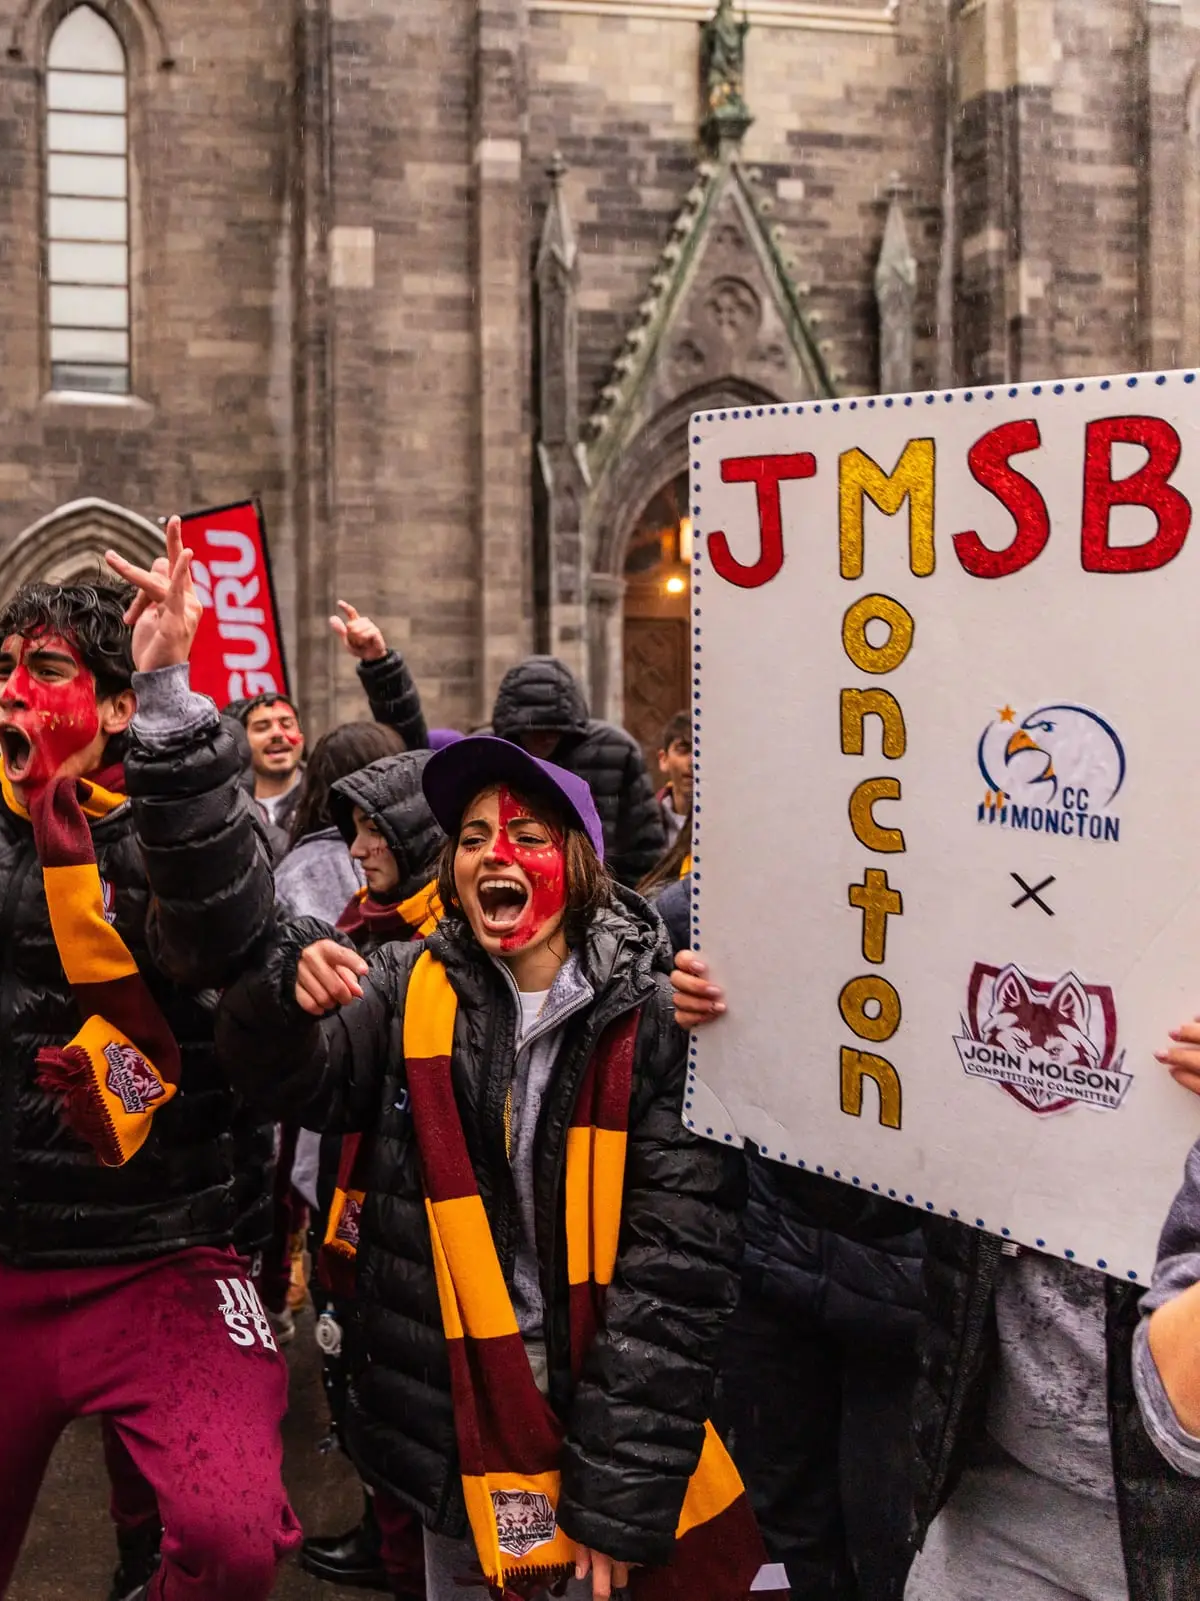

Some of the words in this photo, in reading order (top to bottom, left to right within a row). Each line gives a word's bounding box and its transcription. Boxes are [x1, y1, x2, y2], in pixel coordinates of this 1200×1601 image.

[707, 415, 1193, 589] JMSB
[1062, 786, 1089, 811] CC
[1010, 803, 1120, 842] MONCTON
[963, 1046, 1022, 1071] JOHN
[1028, 1058, 1121, 1094] MOLSON
[966, 1062, 1044, 1088] COMPETITION
[1047, 1081, 1116, 1105] COMMITTEE
[215, 1278, 266, 1317] JM
[224, 1313, 278, 1353] SB
